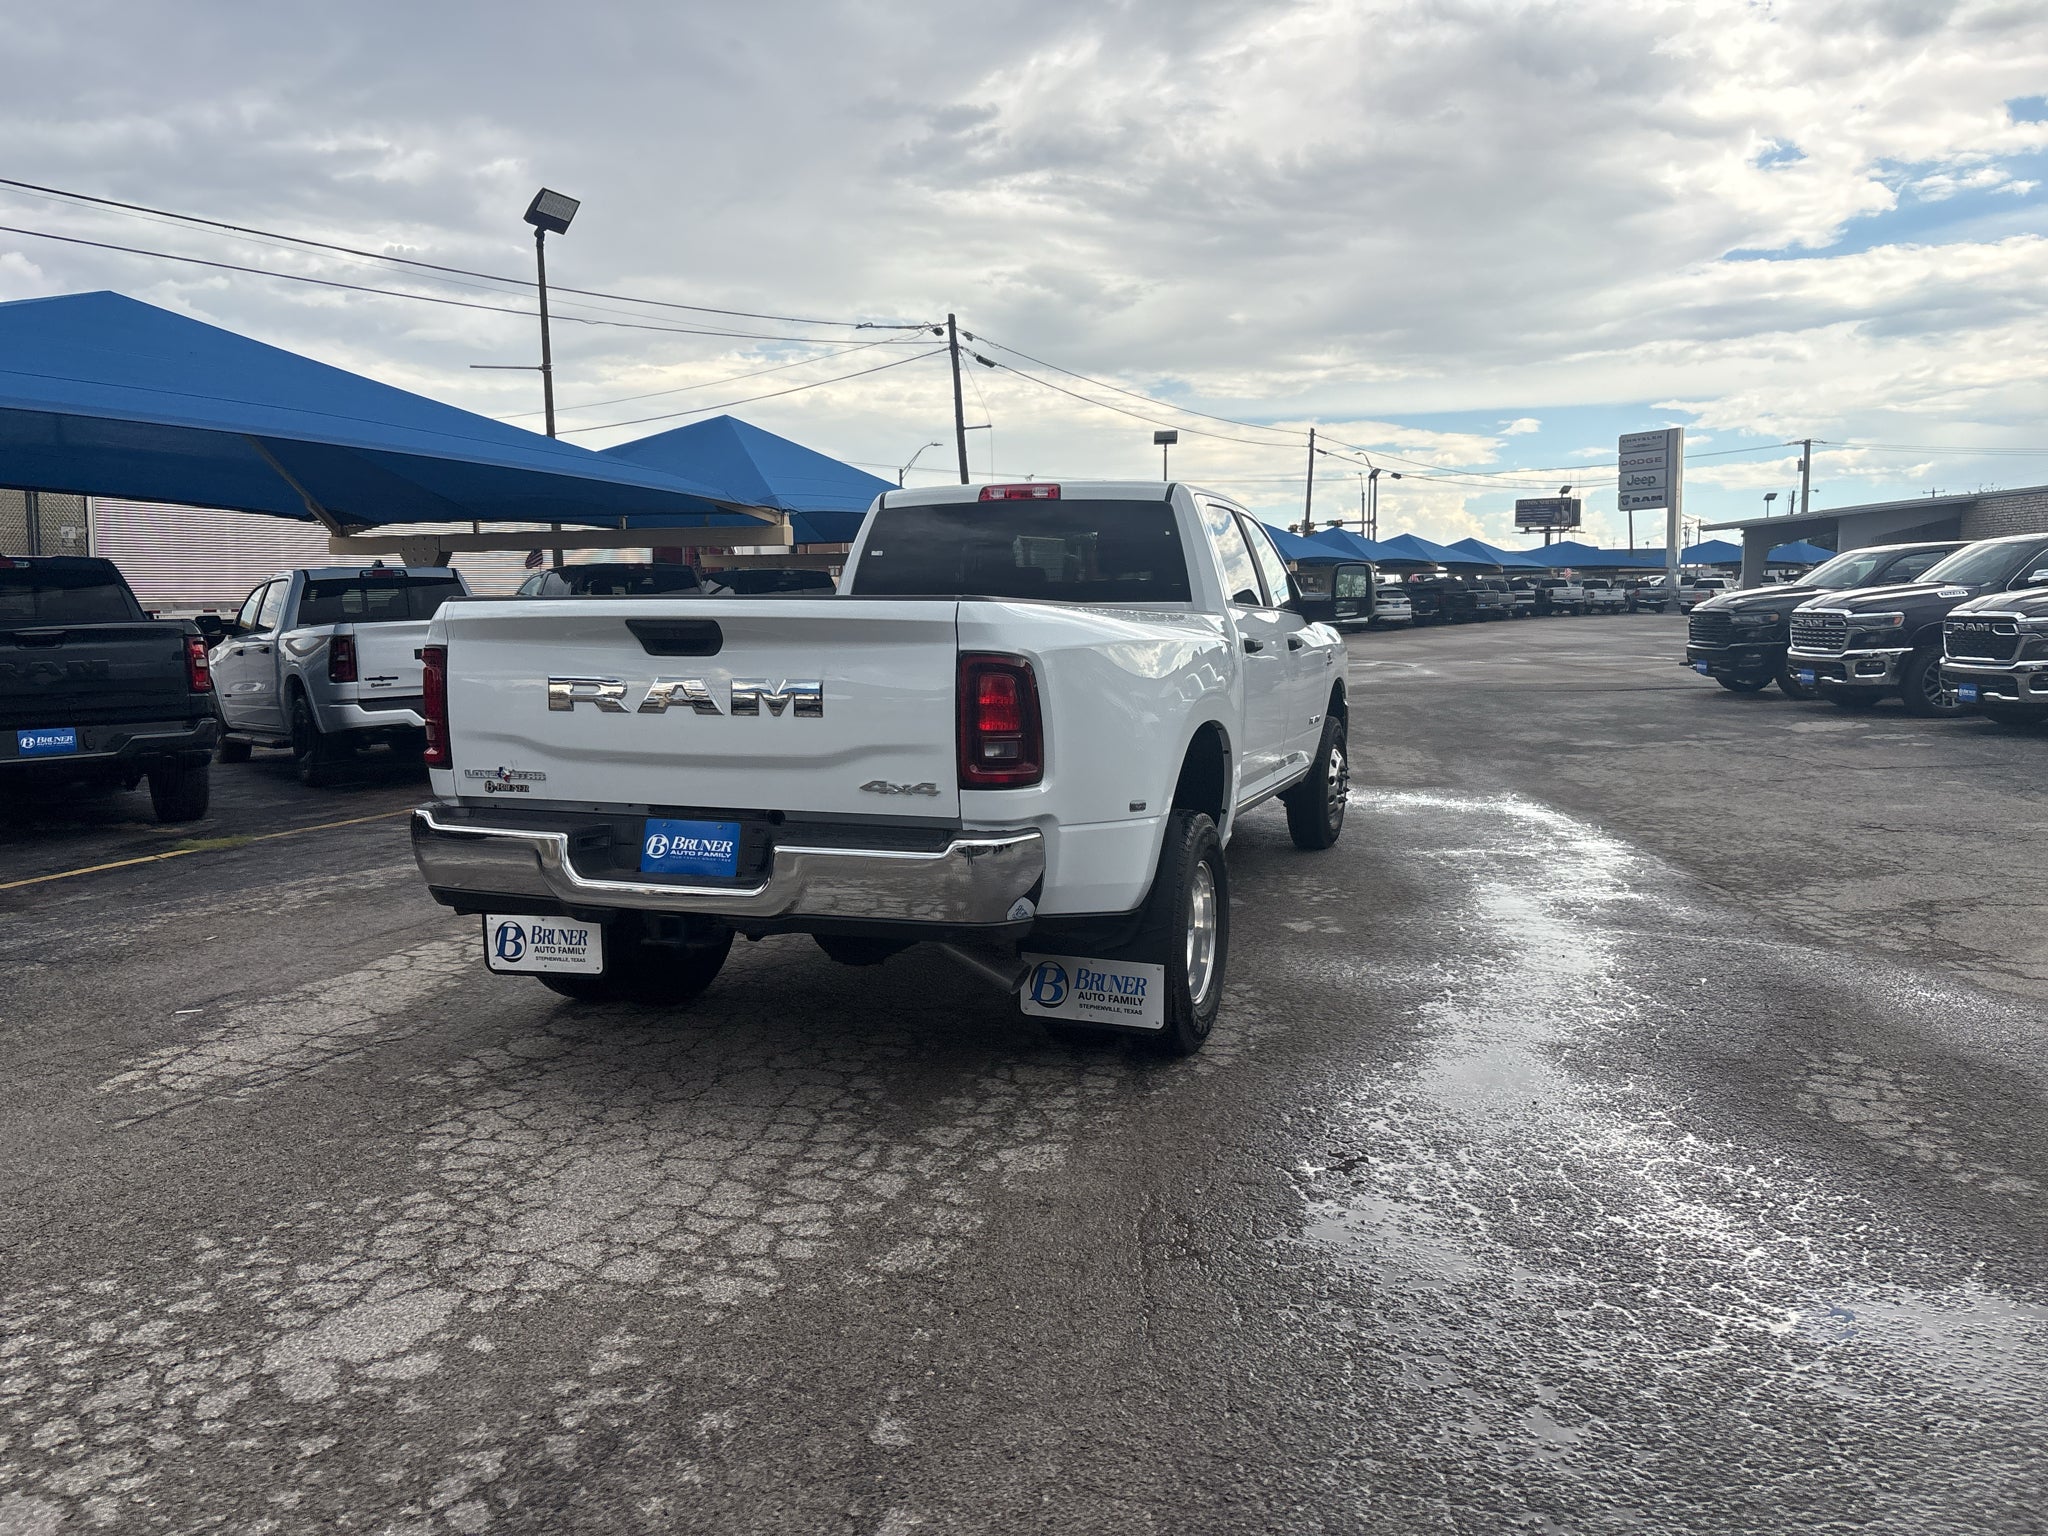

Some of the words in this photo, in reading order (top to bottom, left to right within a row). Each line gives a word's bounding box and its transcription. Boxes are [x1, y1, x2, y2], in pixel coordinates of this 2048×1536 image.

[1621, 457, 1663, 466] DODGE
[1627, 474, 1656, 486] Jeep
[1632, 495, 1663, 503] RAM
[1953, 622, 1990, 632] RAM
[548, 675, 824, 718] RAM
[37, 735, 73, 743] BRUNER
[671, 836, 733, 852] BRUNER
[530, 925, 588, 946] BRUNER
[534, 946, 556, 954] AUTO
[558, 947, 587, 955] FAMILY
[1074, 968, 1148, 996] BRUNER
[1078, 991, 1106, 1002] AUTO
[1108, 993, 1145, 1007] FAMILY
[1124, 1007, 1143, 1016] TEXAS
